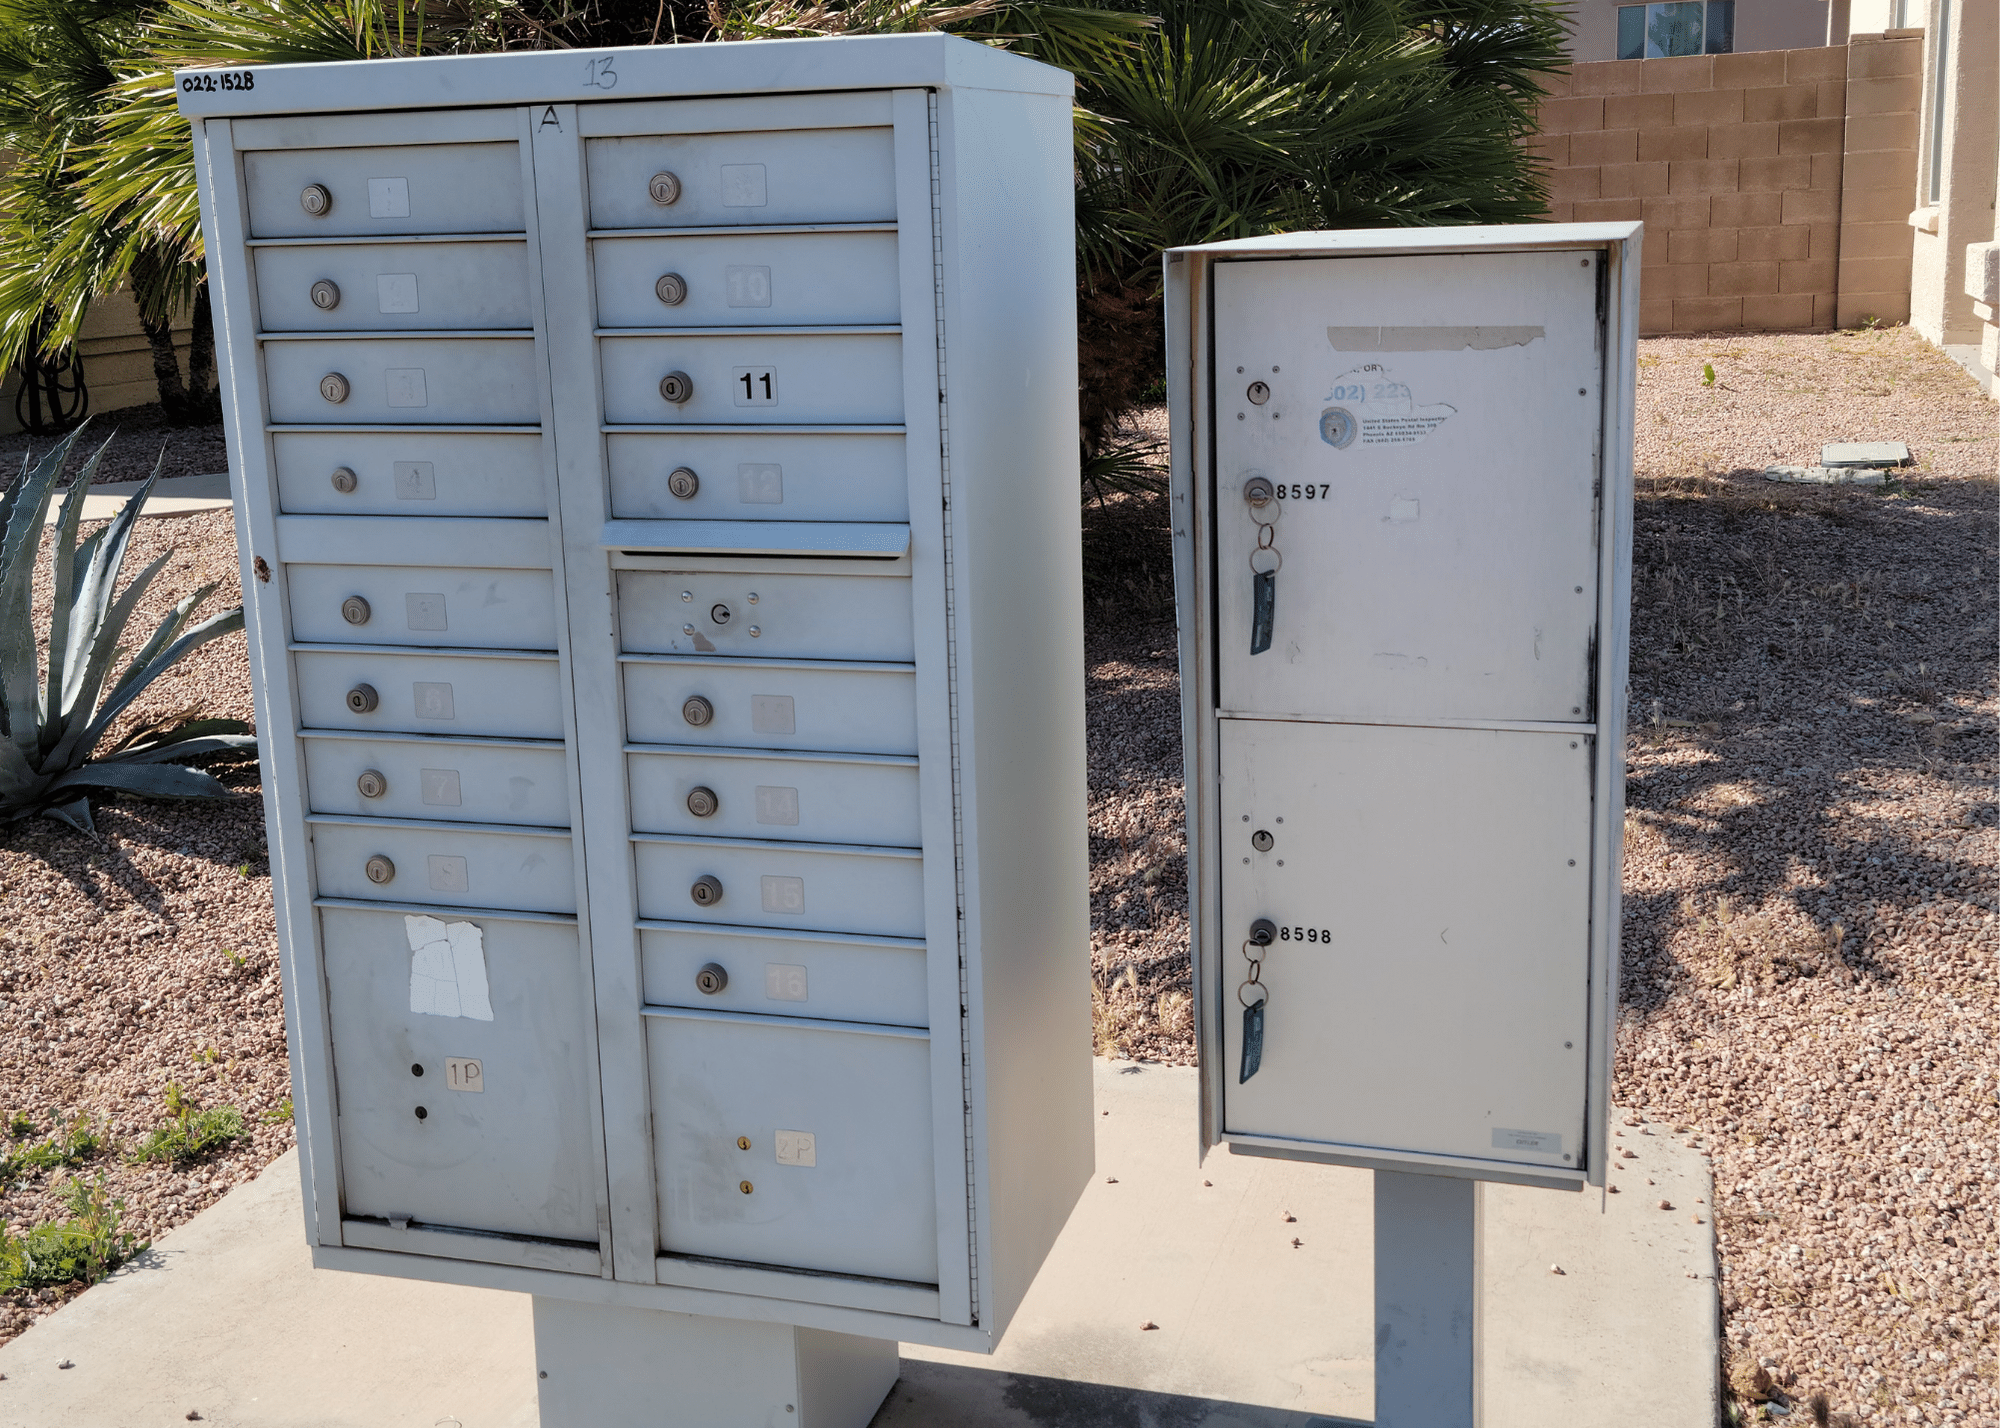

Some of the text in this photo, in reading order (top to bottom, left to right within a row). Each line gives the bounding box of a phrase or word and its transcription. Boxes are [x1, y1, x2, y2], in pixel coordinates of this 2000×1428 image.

[582, 56, 617, 90] 13
[538, 105, 563, 133] A
[729, 272, 768, 301] 10
[740, 373, 772, 400] 11
[743, 470, 778, 497] 12
[1277, 484, 1330, 499] 8597
[432, 775, 448, 800] 7
[763, 792, 794, 819] 14
[768, 882, 801, 909] 15
[1281, 927, 1331, 943] 8598
[770, 970, 803, 997] 16
[451, 1062, 480, 1085] 1P
